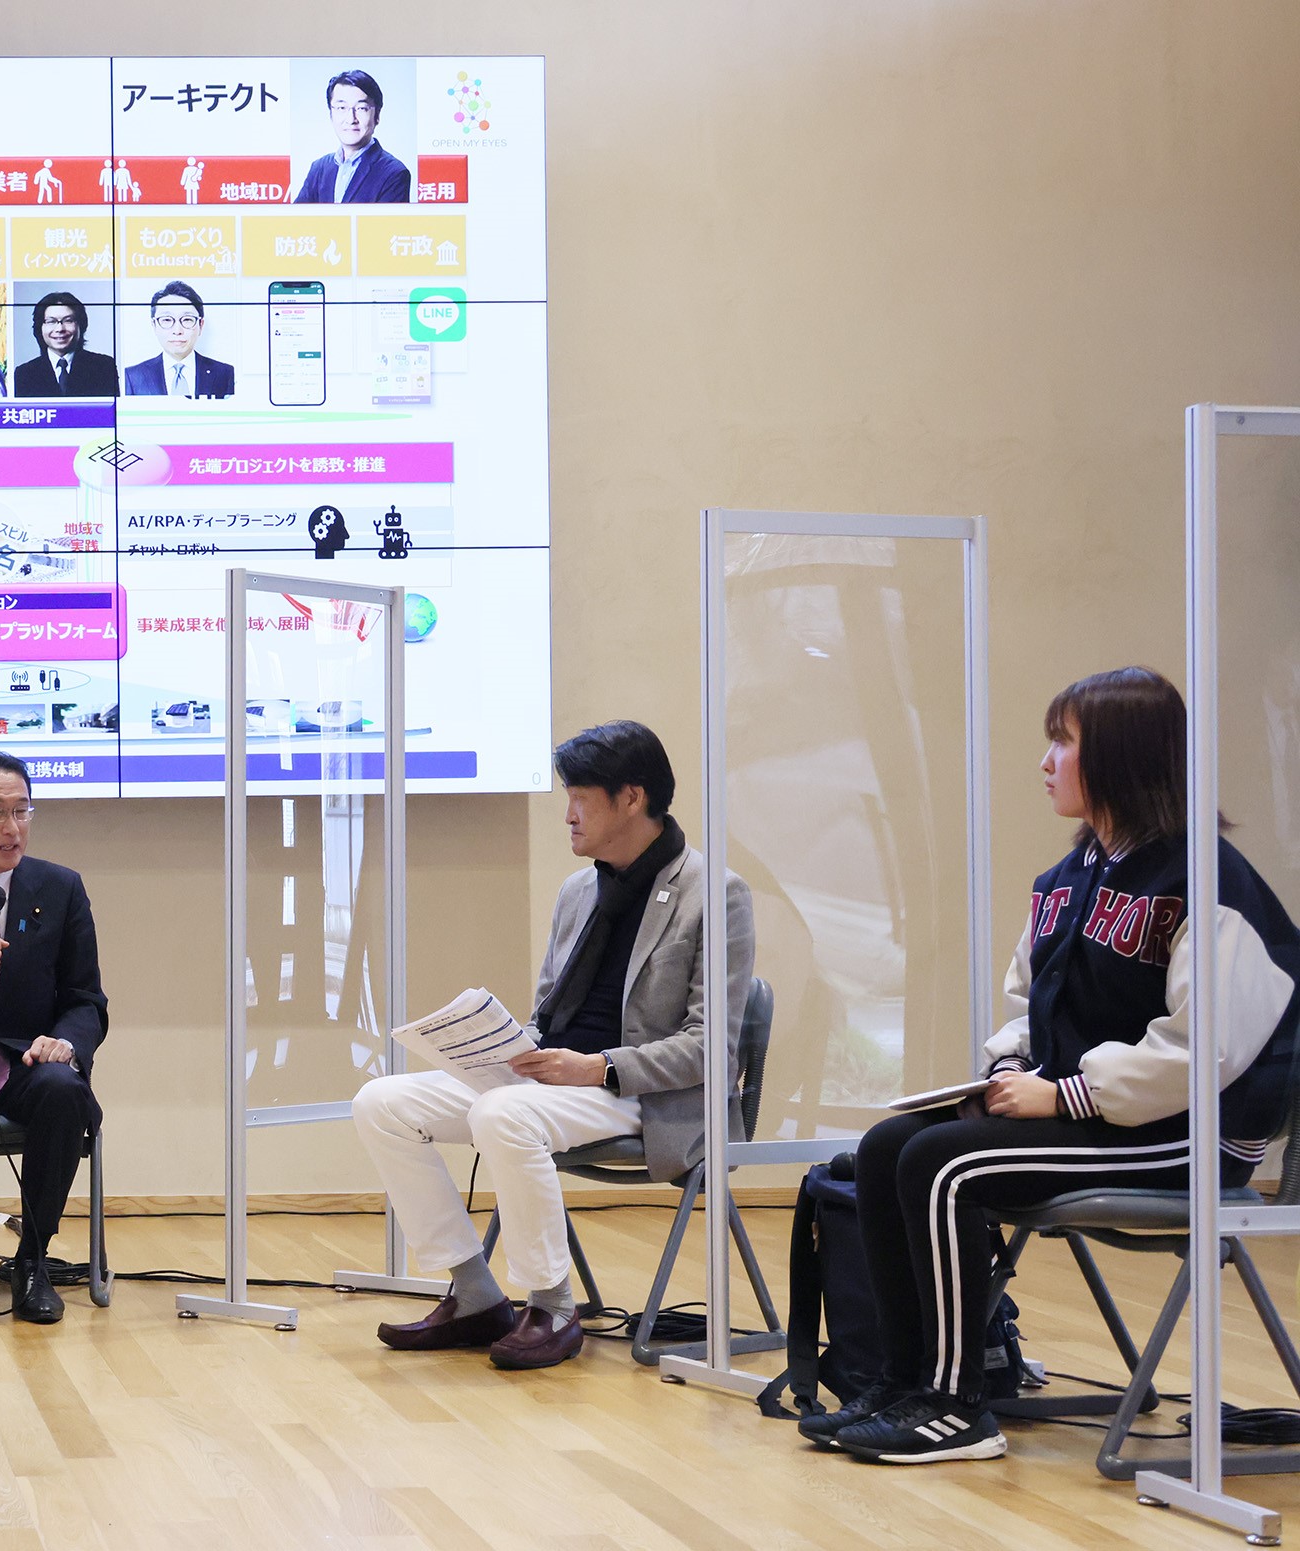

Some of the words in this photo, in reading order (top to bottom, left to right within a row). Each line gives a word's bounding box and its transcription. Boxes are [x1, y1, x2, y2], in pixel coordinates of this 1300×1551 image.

[121, 82, 278, 113] アーキテクト
[432, 139, 460, 148] OPEN
[463, 139, 479, 148] MY
[481, 138, 507, 148] EYES
[418, 182, 456, 201] 活用
[43, 227, 88, 249] 観光
[139, 226, 223, 249] ものづくり
[274, 236, 318, 258] 防災
[389, 234, 433, 258] 行政
[423, 308, 453, 318] LINE
[188, 456, 387, 475] 先端プロジェクトを誘致・推進
[63, 521, 104, 536] 地域で
[127, 512, 298, 530] AI/RPA・ディープラーニング
[137, 615, 310, 633] 事業成果を他域へ展開
